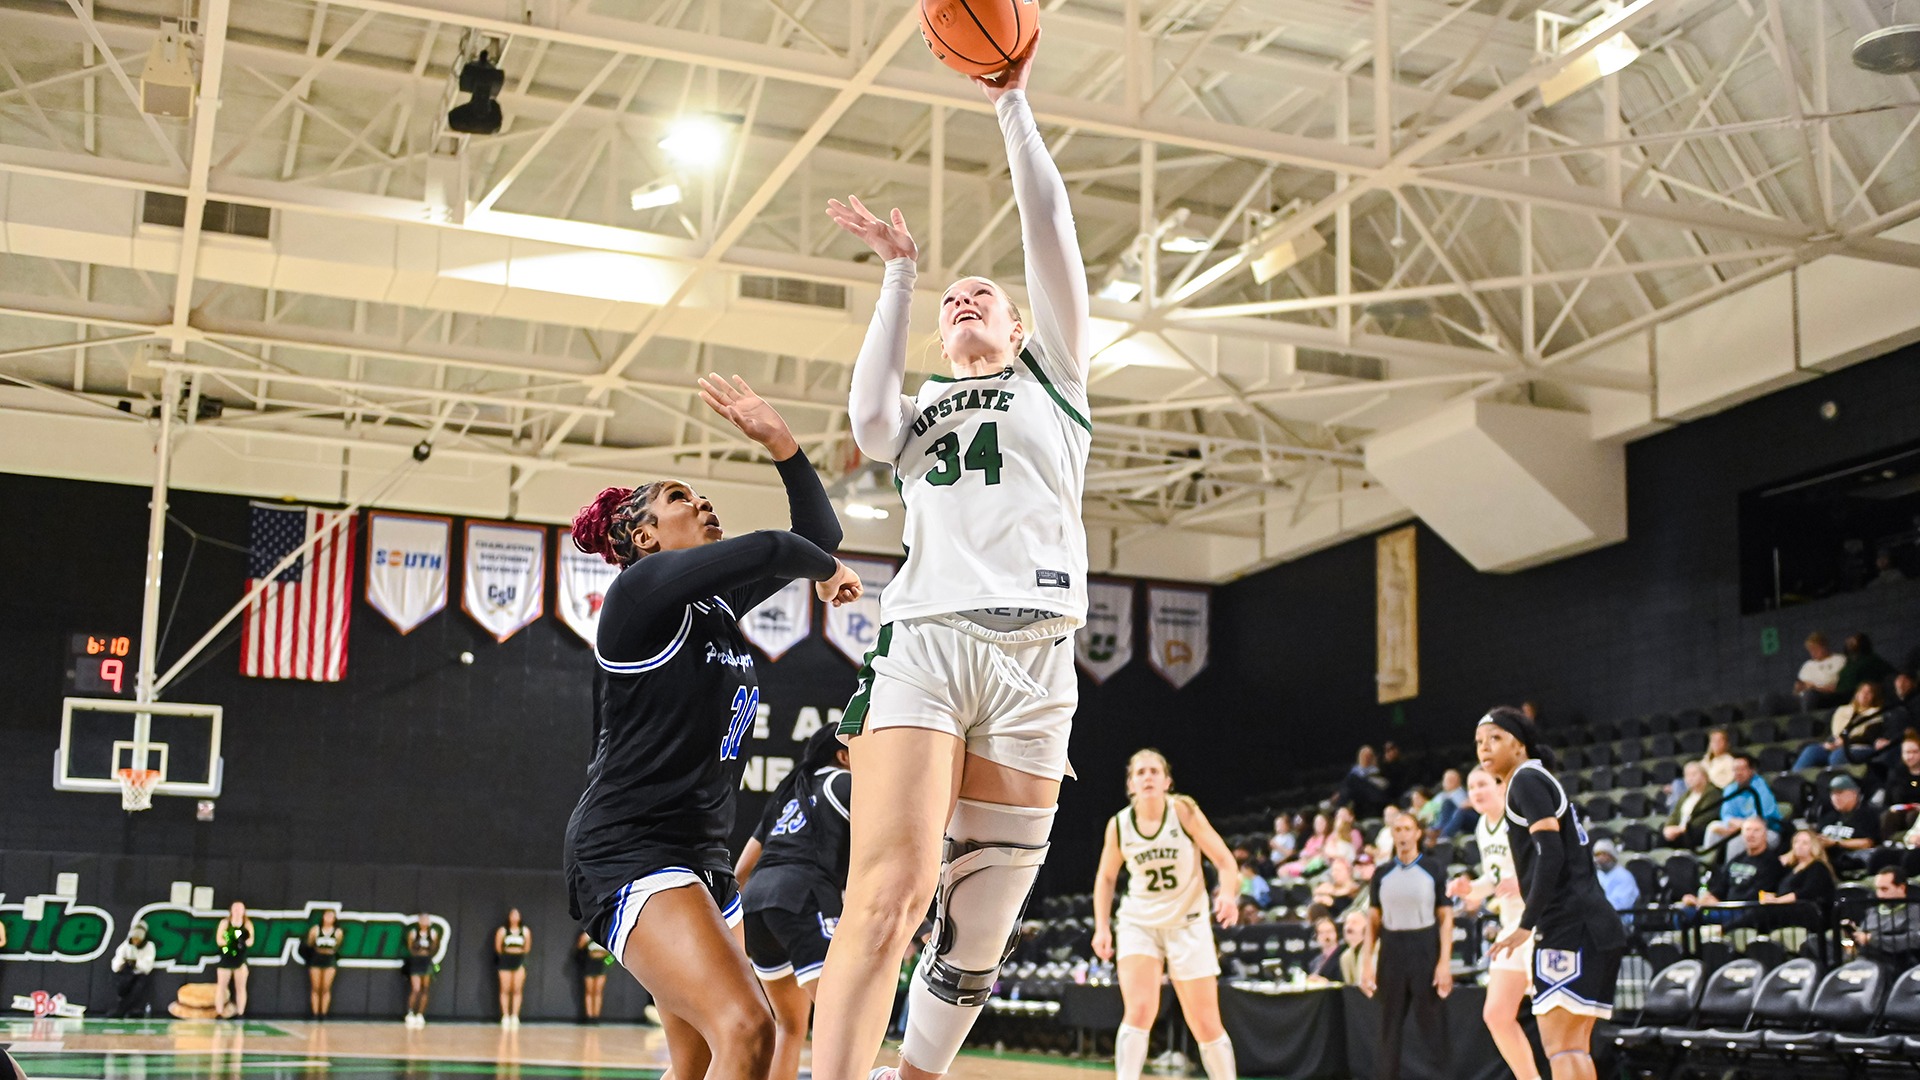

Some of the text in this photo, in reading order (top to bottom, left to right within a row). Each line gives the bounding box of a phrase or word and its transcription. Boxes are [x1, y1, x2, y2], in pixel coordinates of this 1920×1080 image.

[912, 389, 1015, 437] UPSTATE
[925, 421, 1003, 487] 34
[376, 549, 442, 570] SOUTH
[87, 635, 130, 657] 6:10
[101, 658, 124, 693] 9
[720, 685, 760, 762] 30
[1134, 847, 1178, 865] UPSTATE
[1145, 865, 1178, 892] 25
[1490, 863, 1501, 886] 3
